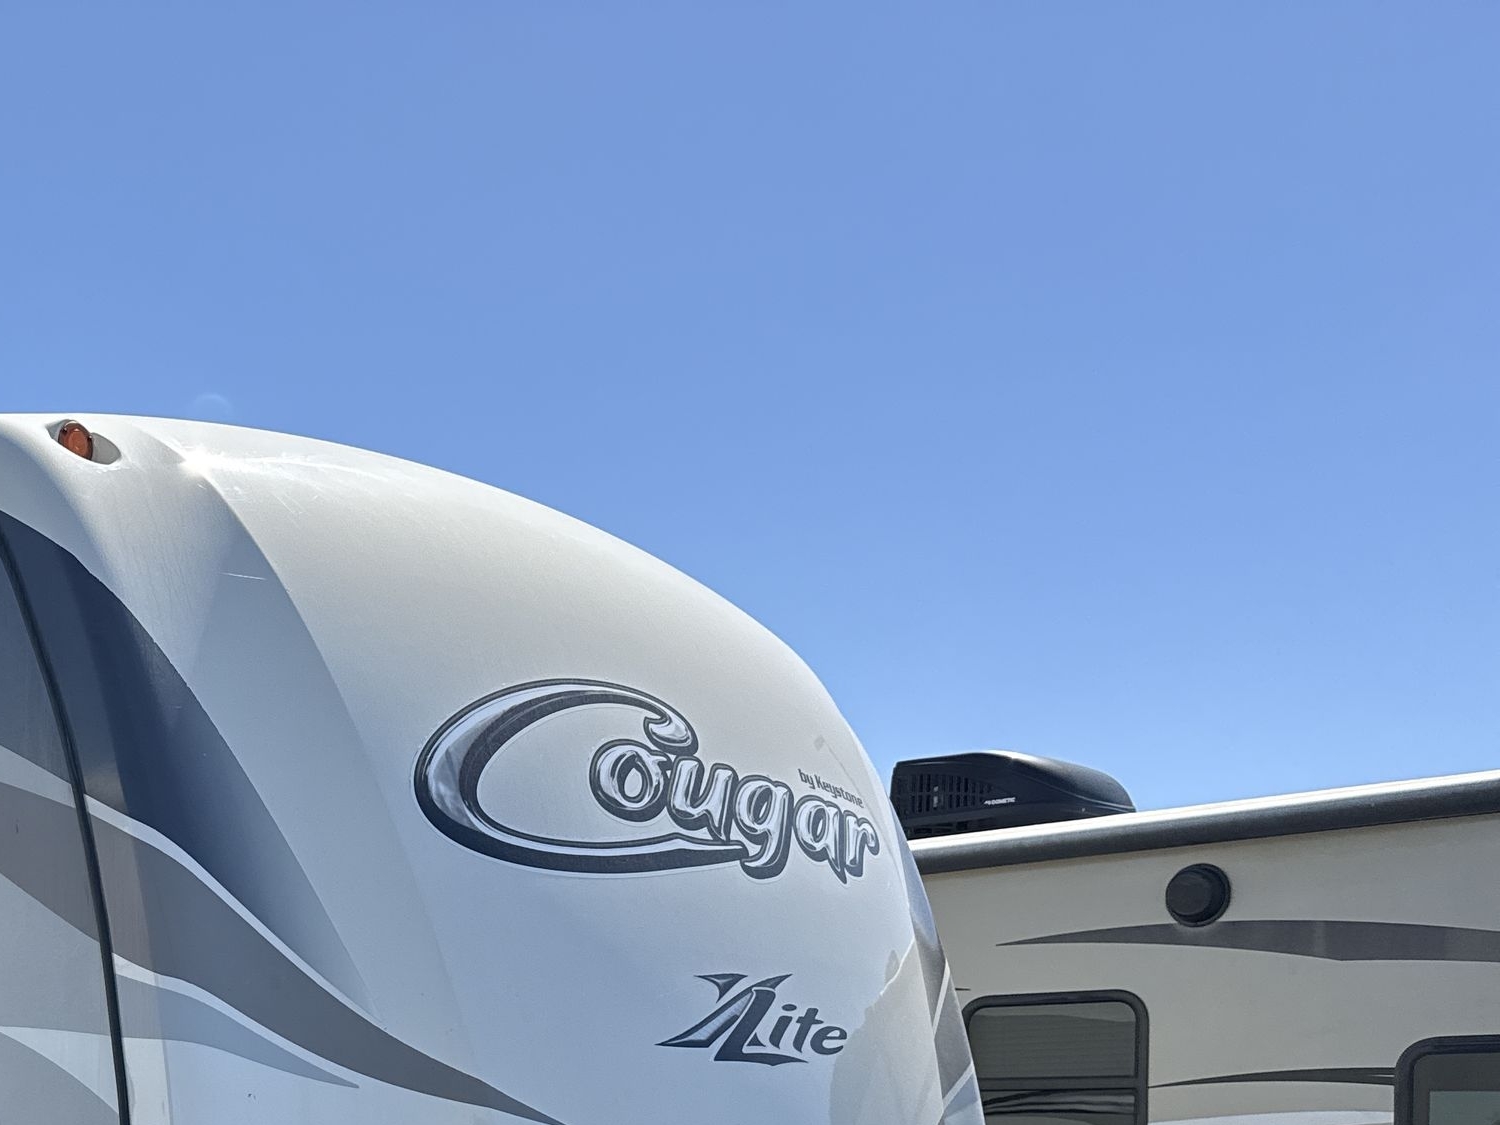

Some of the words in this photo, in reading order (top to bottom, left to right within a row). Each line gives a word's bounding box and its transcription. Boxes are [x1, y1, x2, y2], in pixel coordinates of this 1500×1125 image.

[413, 678, 880, 884] Cougar
[797, 768, 815, 789] by
[814, 774, 864, 808] Keystone
